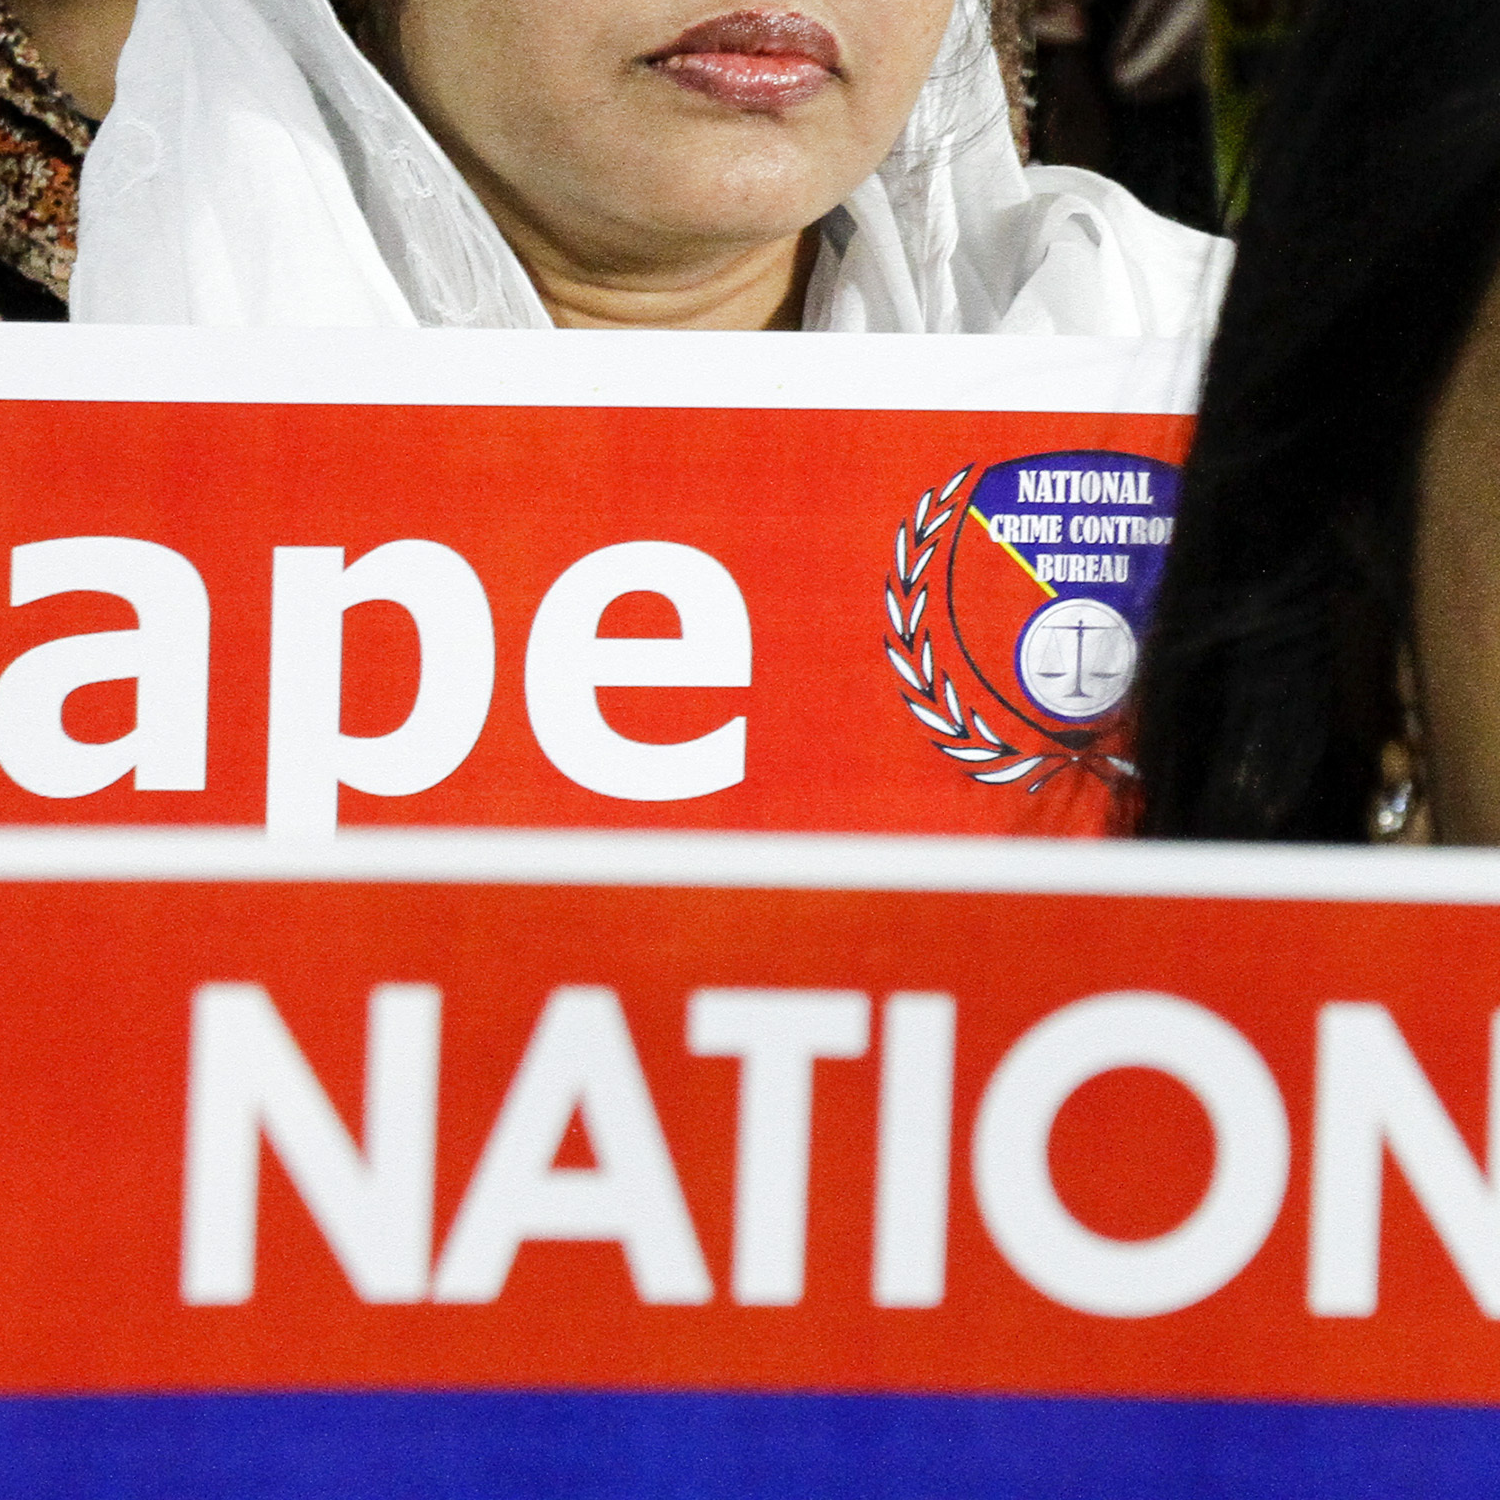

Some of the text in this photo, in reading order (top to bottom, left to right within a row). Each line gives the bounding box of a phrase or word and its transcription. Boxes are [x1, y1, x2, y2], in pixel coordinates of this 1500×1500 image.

[1016, 469, 1154, 505] NATIONAL
[987, 513, 1063, 544] CRIME
[1032, 553, 1130, 583] BUREAU
